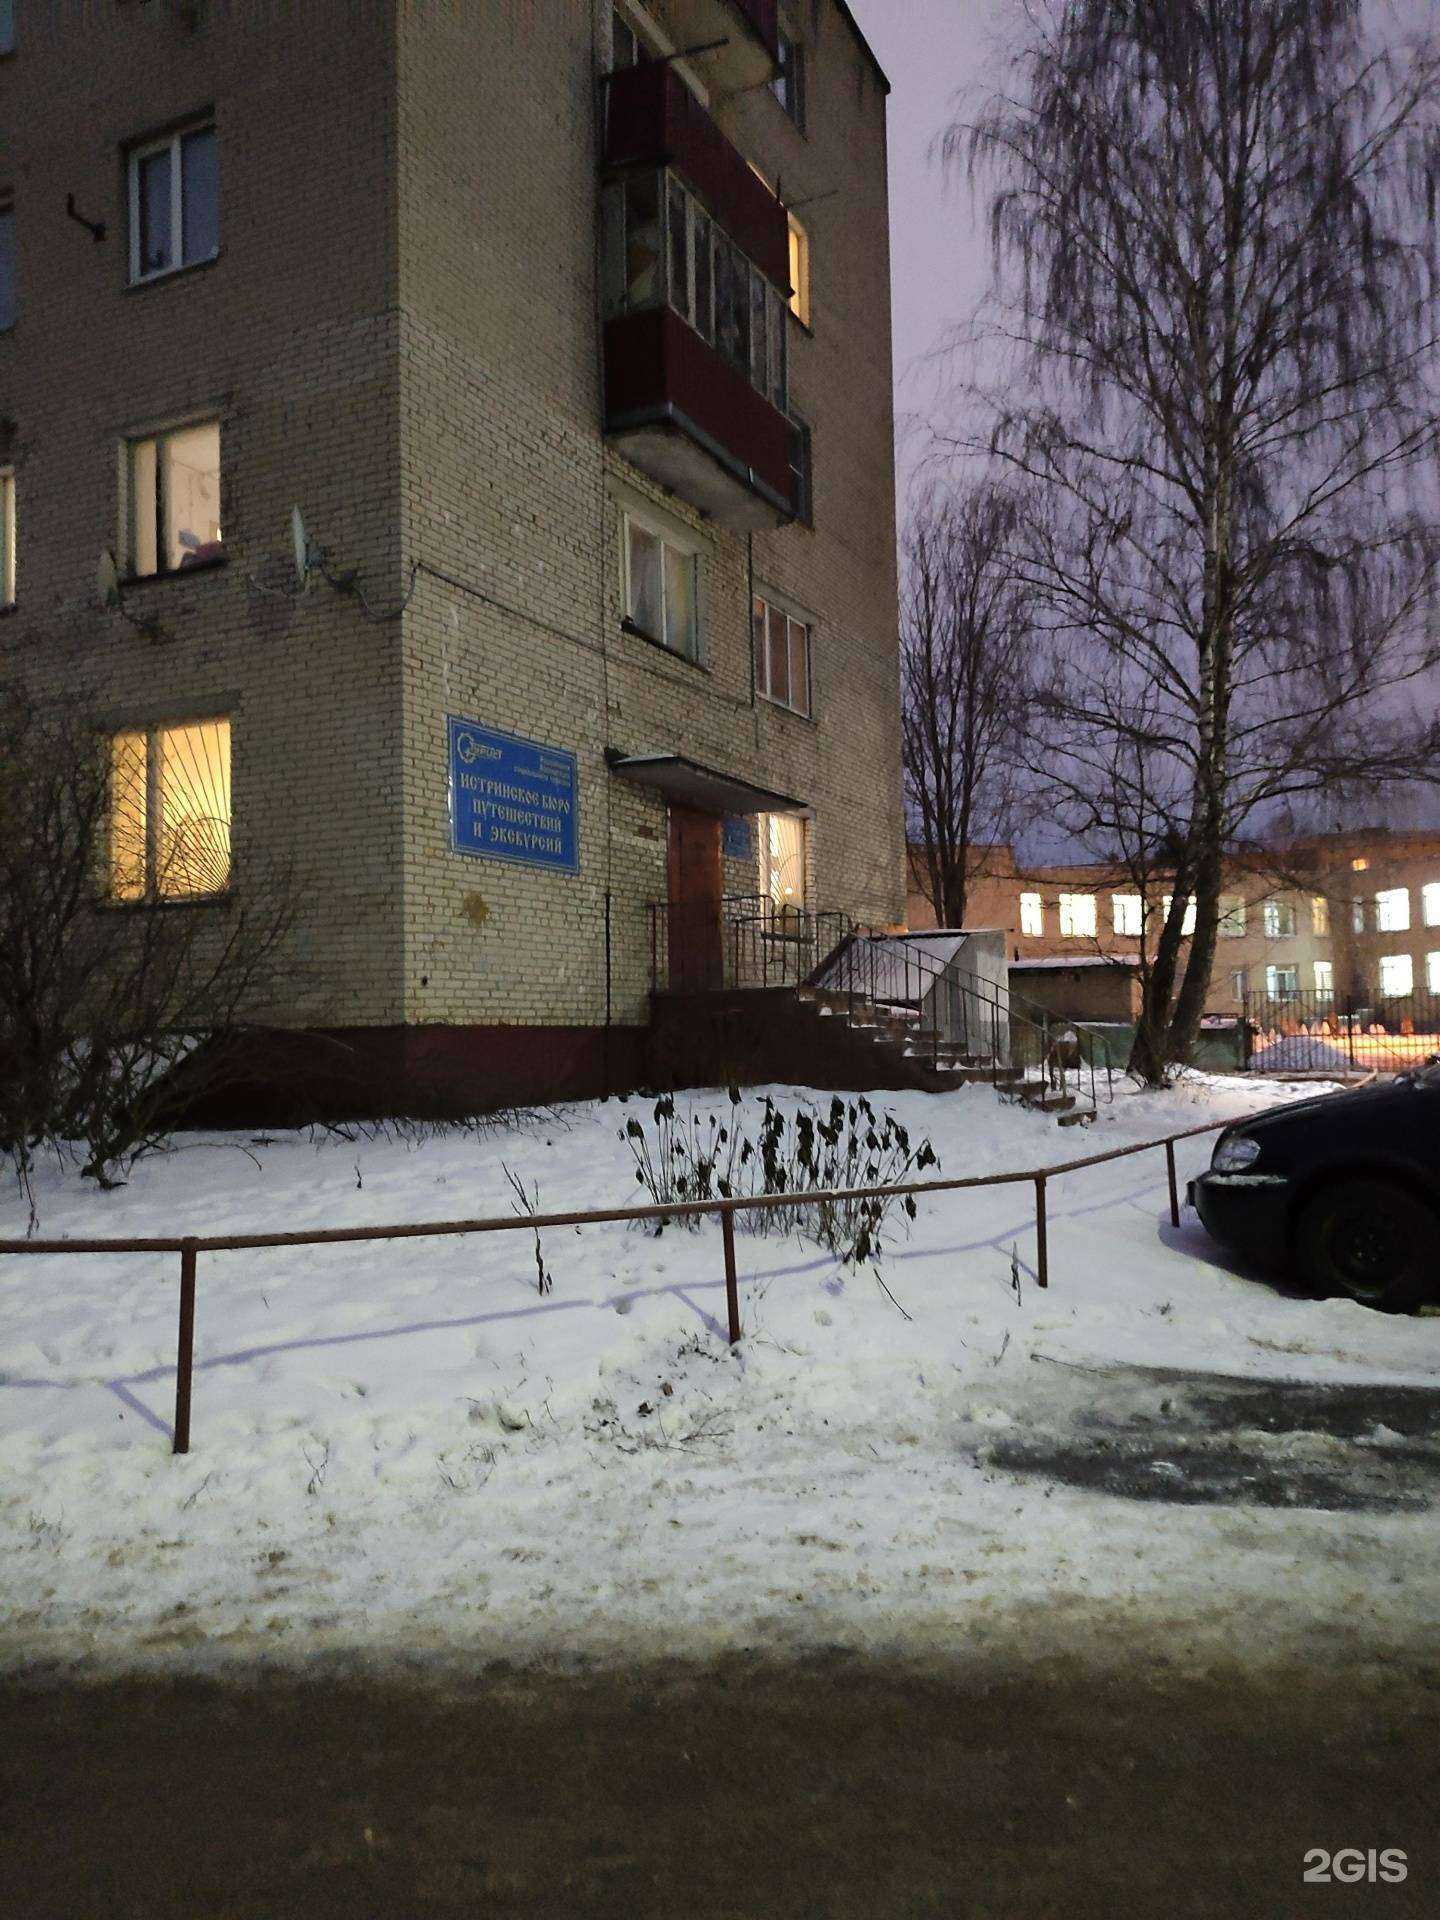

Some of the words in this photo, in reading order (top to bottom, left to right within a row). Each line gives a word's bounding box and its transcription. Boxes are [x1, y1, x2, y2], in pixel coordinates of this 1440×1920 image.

[460, 772, 540, 807] ИСТРИНСКОЕ
[542, 794, 570, 814] БЮРО
[473, 798, 561, 833] ПУТЕШЕСТВИЙ
[473, 821, 482, 838] И
[490, 825, 562, 854] ЭКСКУРСИЙ
